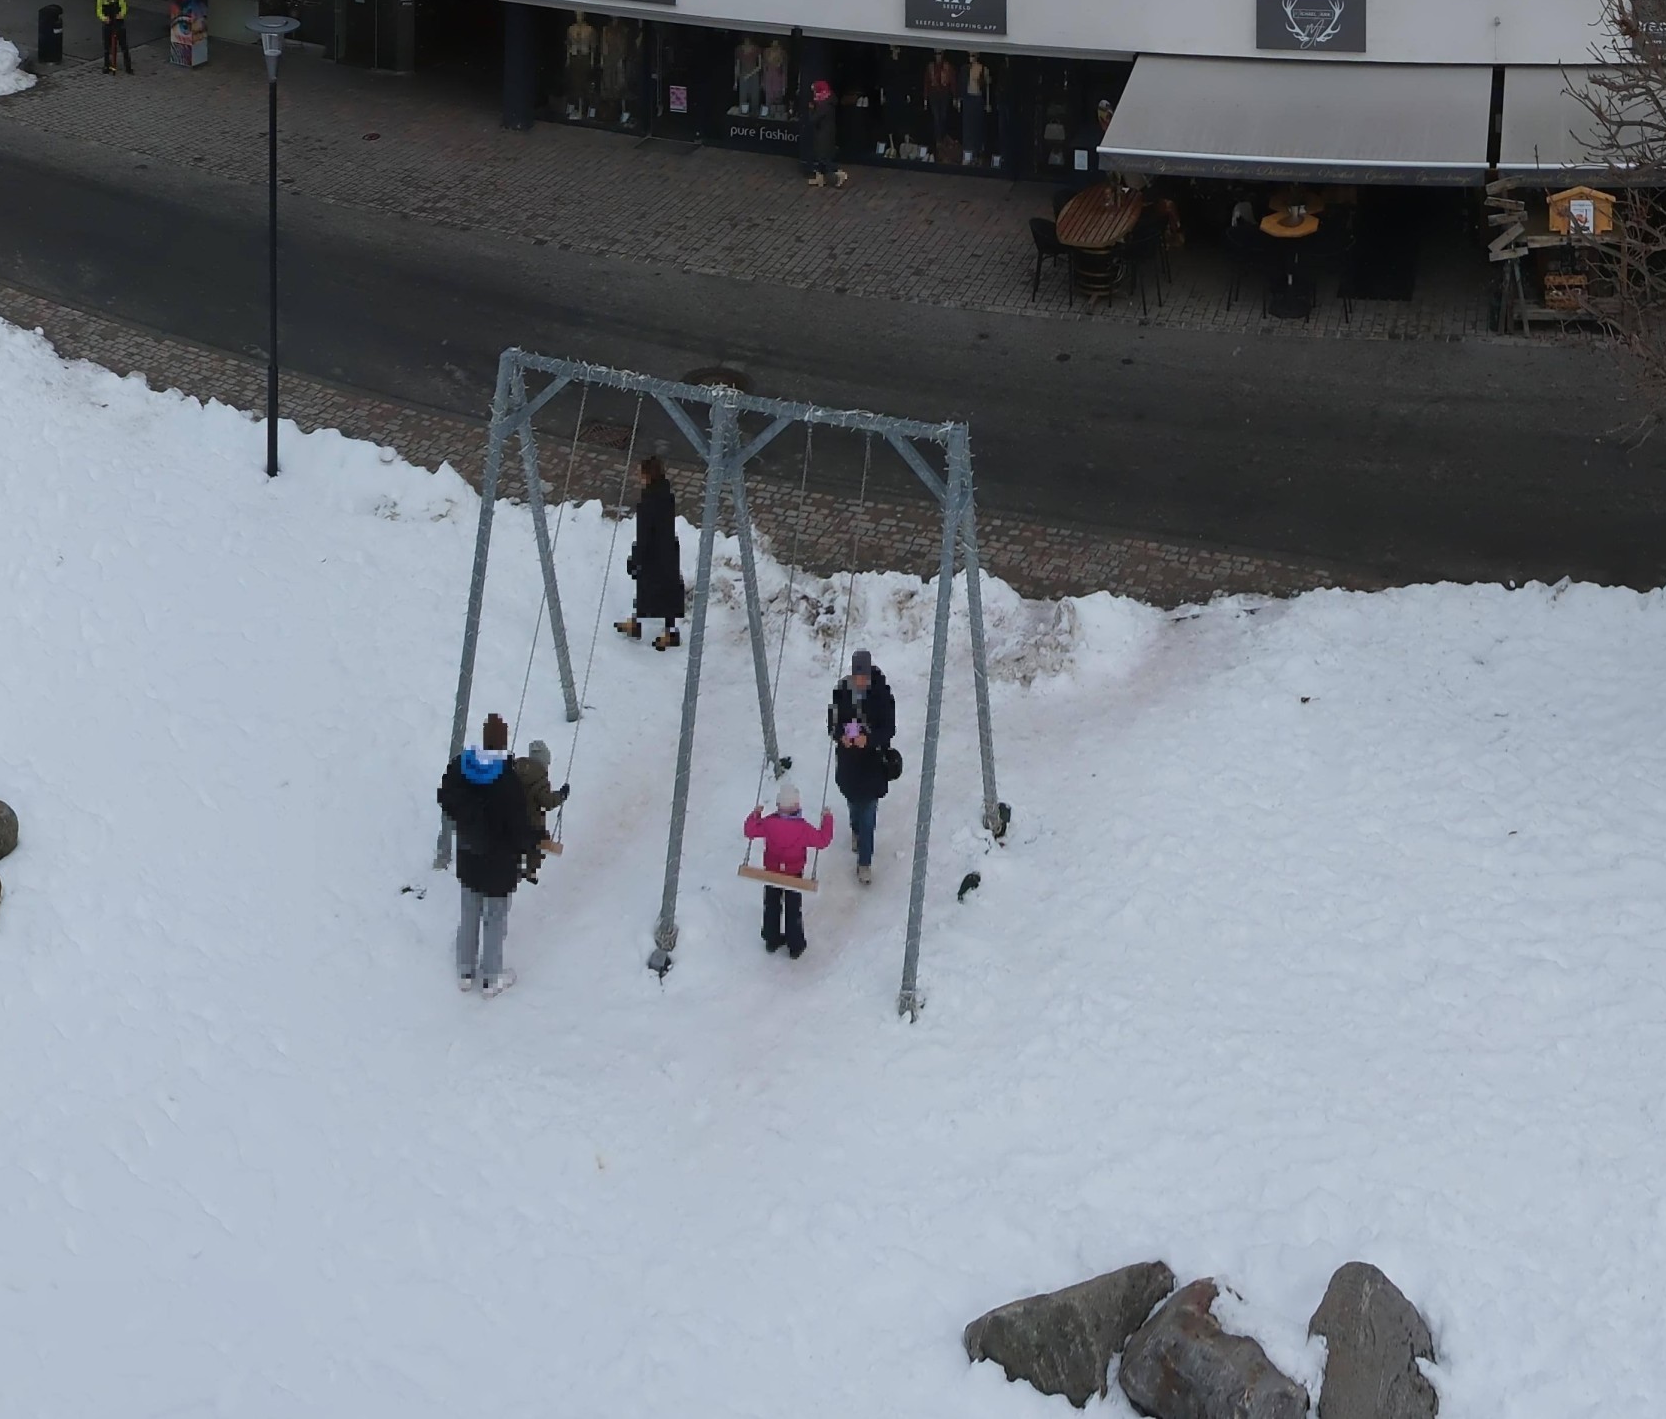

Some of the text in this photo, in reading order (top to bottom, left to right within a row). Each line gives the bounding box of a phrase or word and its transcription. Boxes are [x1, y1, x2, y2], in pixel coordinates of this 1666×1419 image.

[915, 19, 944, 27] SEEFELD
[946, 22, 982, 30] SHOPPING
[730, 126, 756, 138] pure
